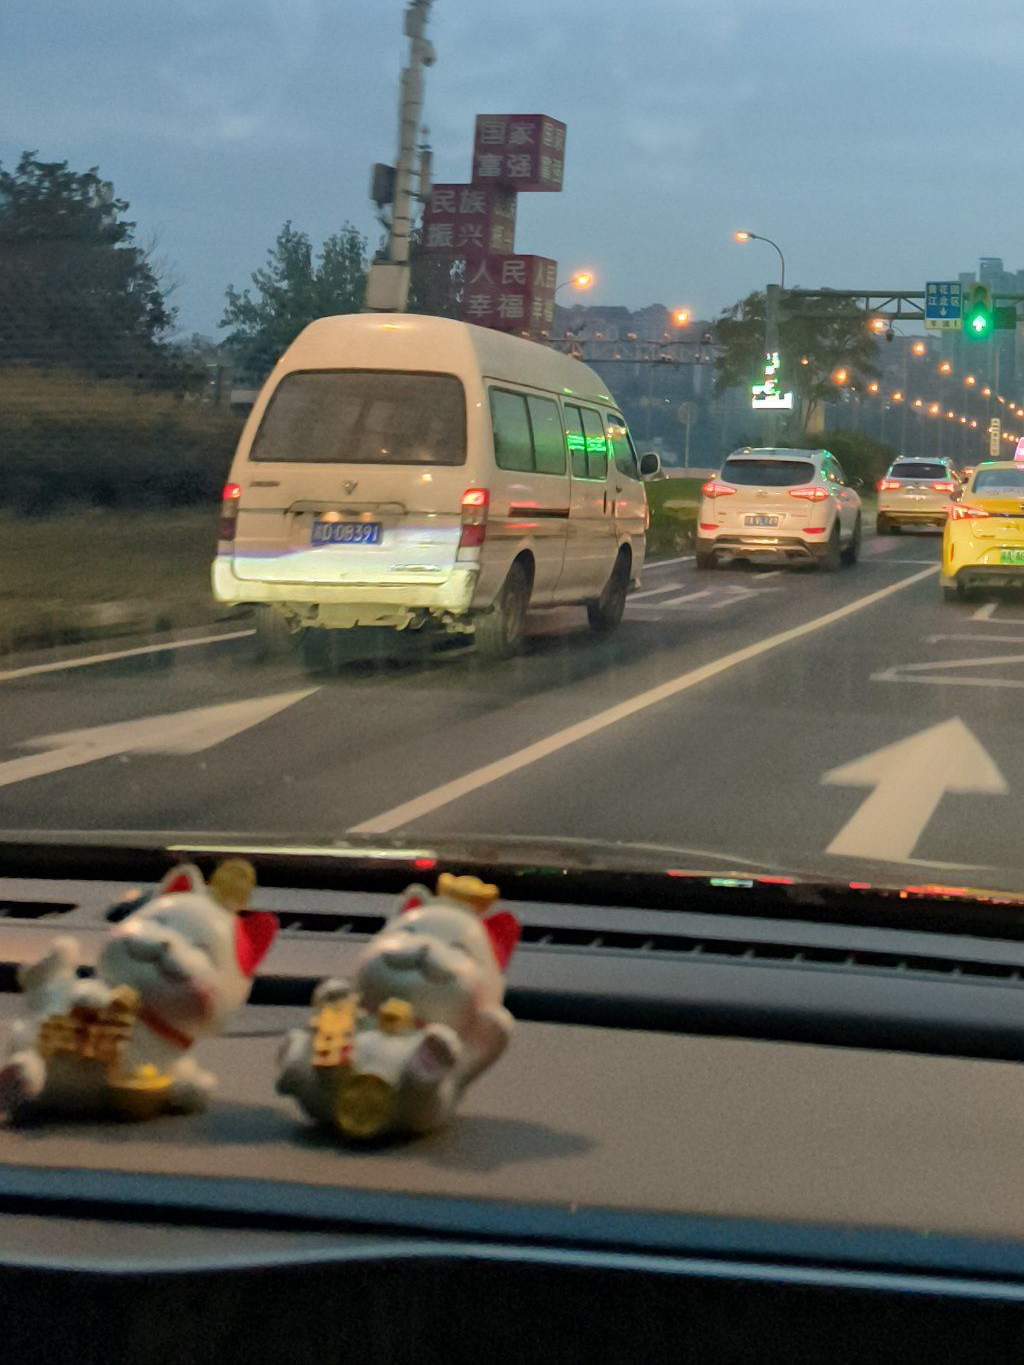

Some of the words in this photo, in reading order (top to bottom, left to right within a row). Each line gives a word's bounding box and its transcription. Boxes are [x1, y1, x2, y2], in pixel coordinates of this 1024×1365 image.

[480, 120, 537, 145] 国家
[478, 152, 533, 178] 富强
[431, 189, 487, 215] 民族
[425, 222, 484, 248] 振兴
[469, 258, 527, 285] 人民
[466, 293, 525, 319] 幸福
